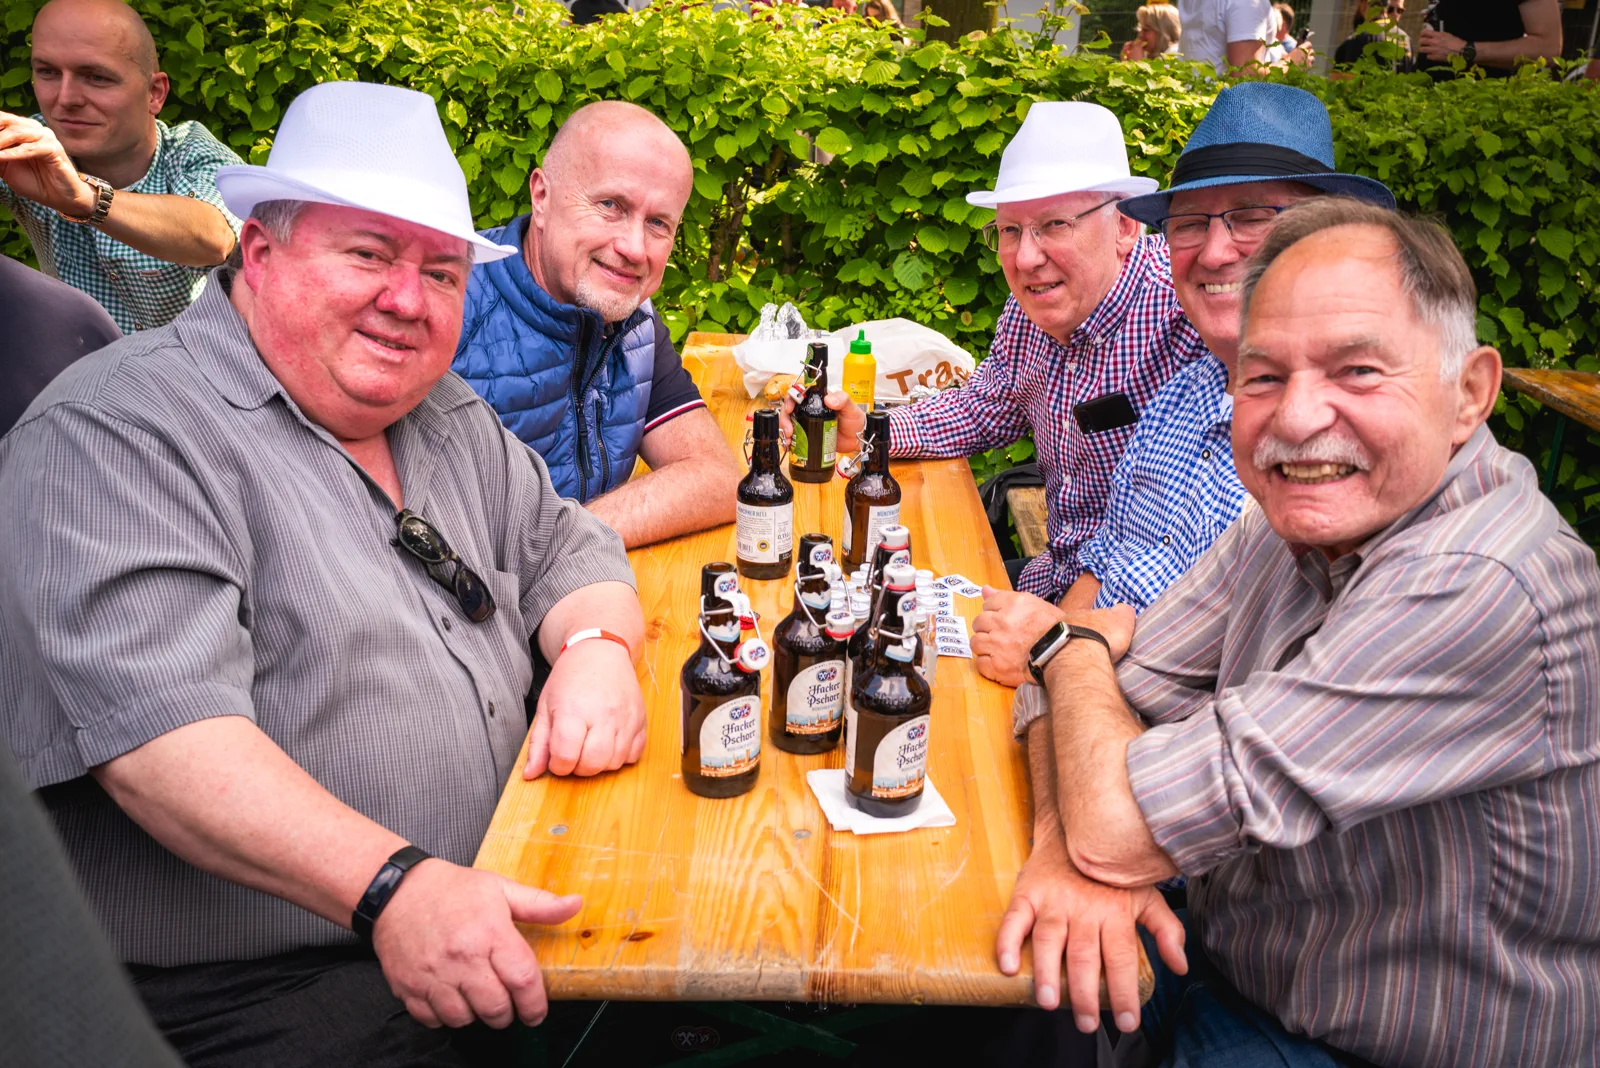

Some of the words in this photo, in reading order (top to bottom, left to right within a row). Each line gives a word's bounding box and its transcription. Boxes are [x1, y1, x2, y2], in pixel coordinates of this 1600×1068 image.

[808, 682, 840, 696] Hacker
[807, 693, 840, 708] Pschorr
[722, 719, 756, 736] Hacker
[721, 730, 756, 748] Pschorr
